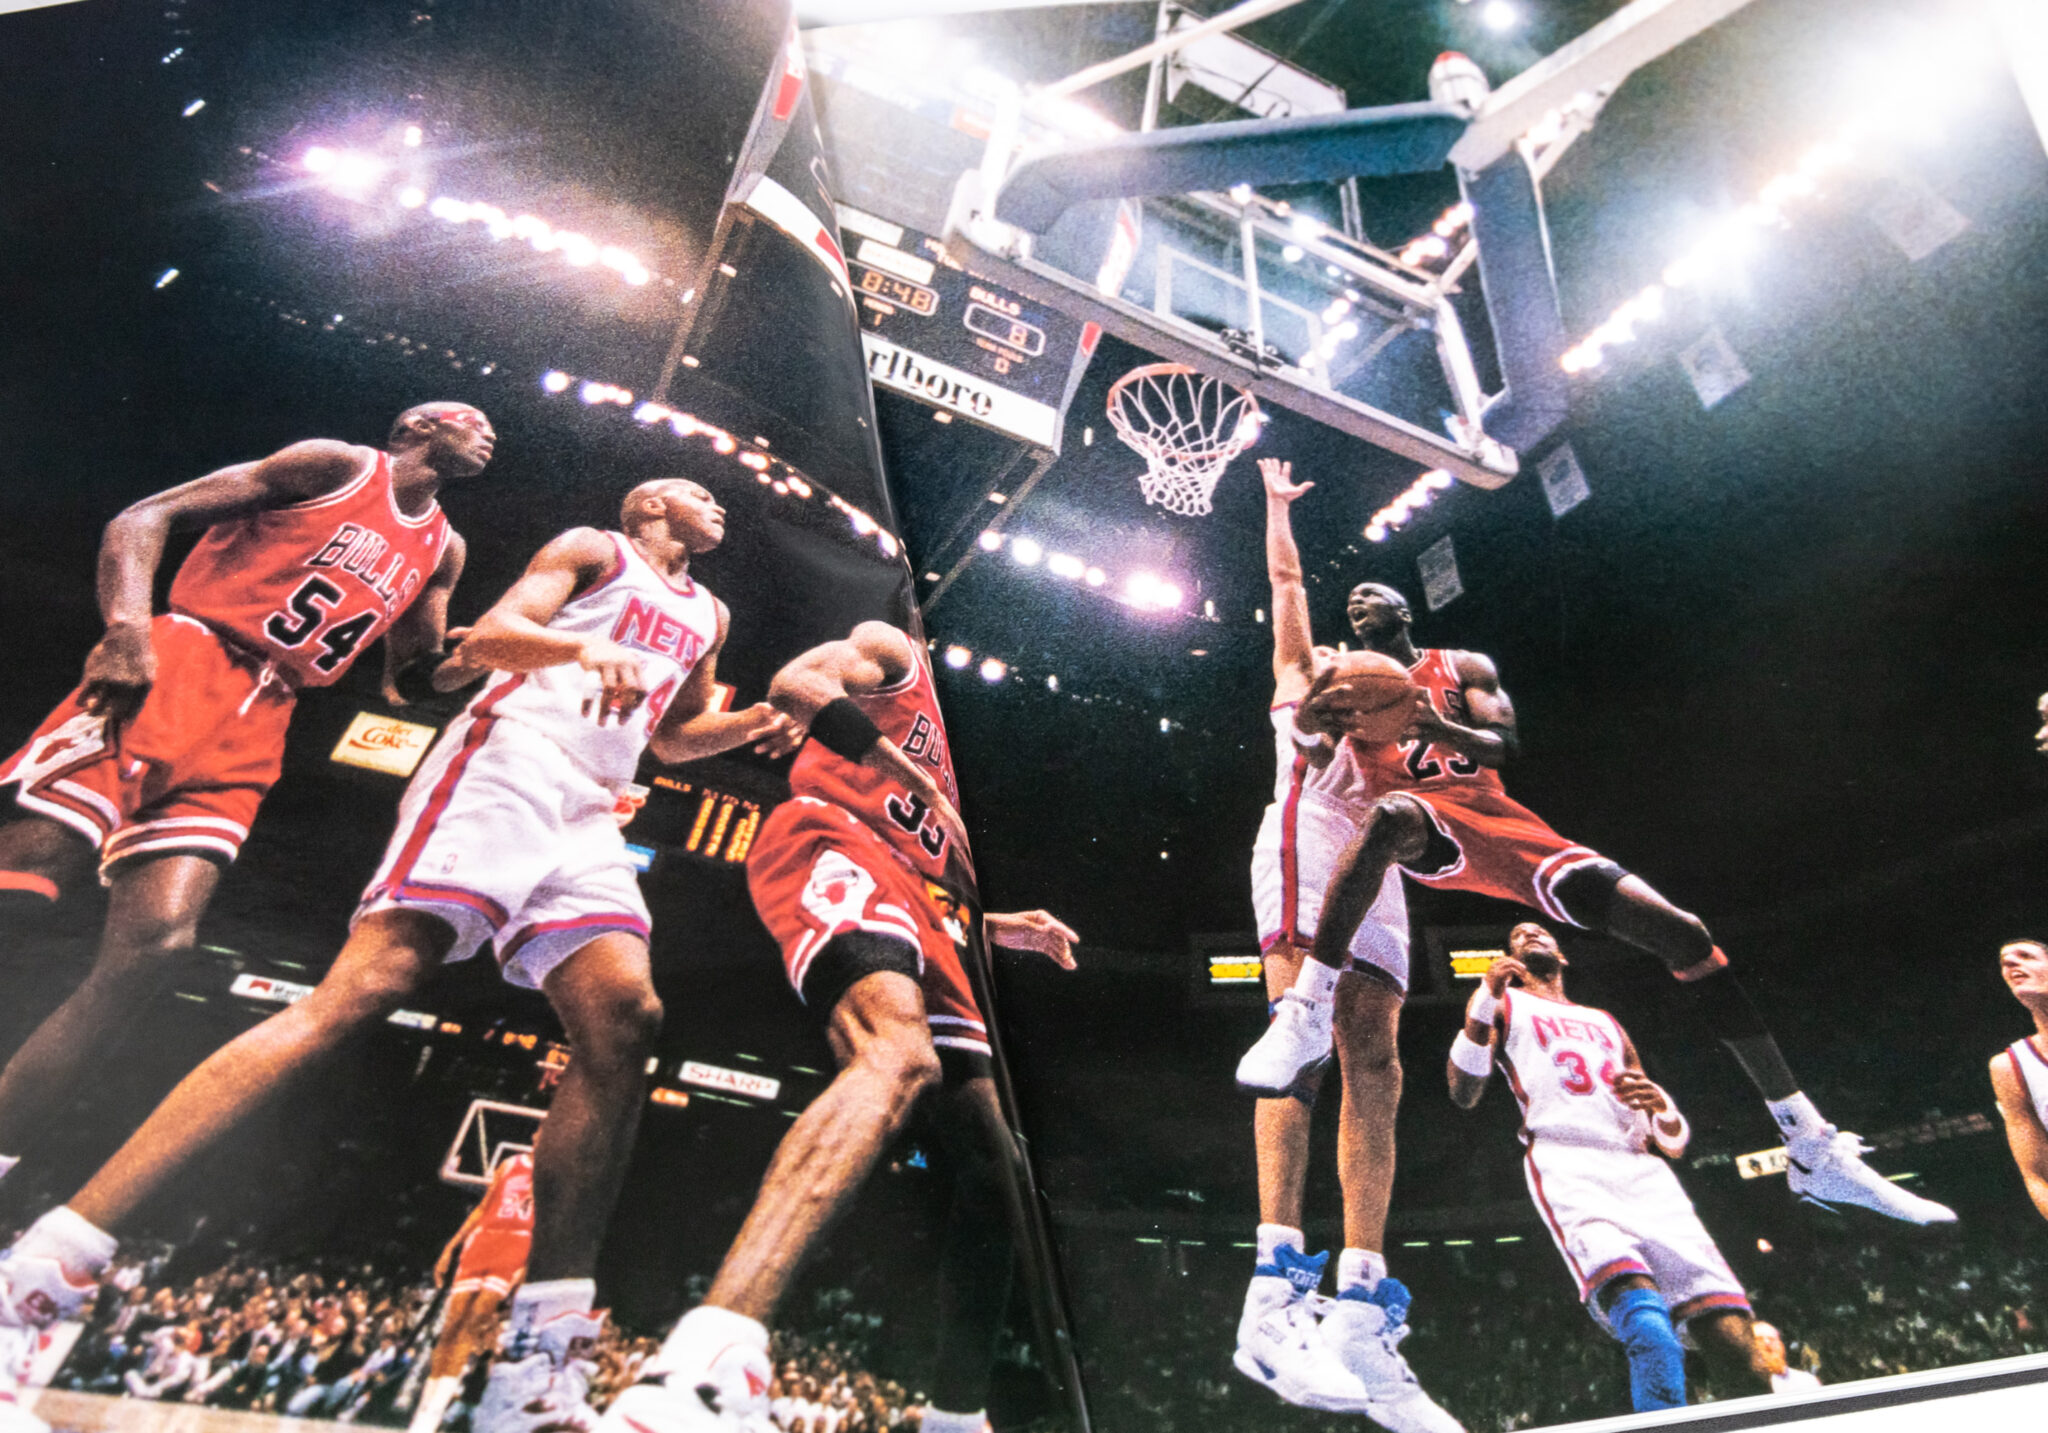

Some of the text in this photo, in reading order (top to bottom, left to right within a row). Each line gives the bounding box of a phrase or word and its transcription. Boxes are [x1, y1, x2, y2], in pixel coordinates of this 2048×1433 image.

[862, 269, 932, 312] 8:48
[969, 286, 1021, 316] BULLS
[1009, 324, 1027, 347] 8
[263, 572, 382, 675] 54
[610, 593, 706, 673] NETS
[353, 727, 418, 751] Coke
[1531, 1014, 1614, 1050] NETS
[688, 1064, 773, 1091] SHARP
